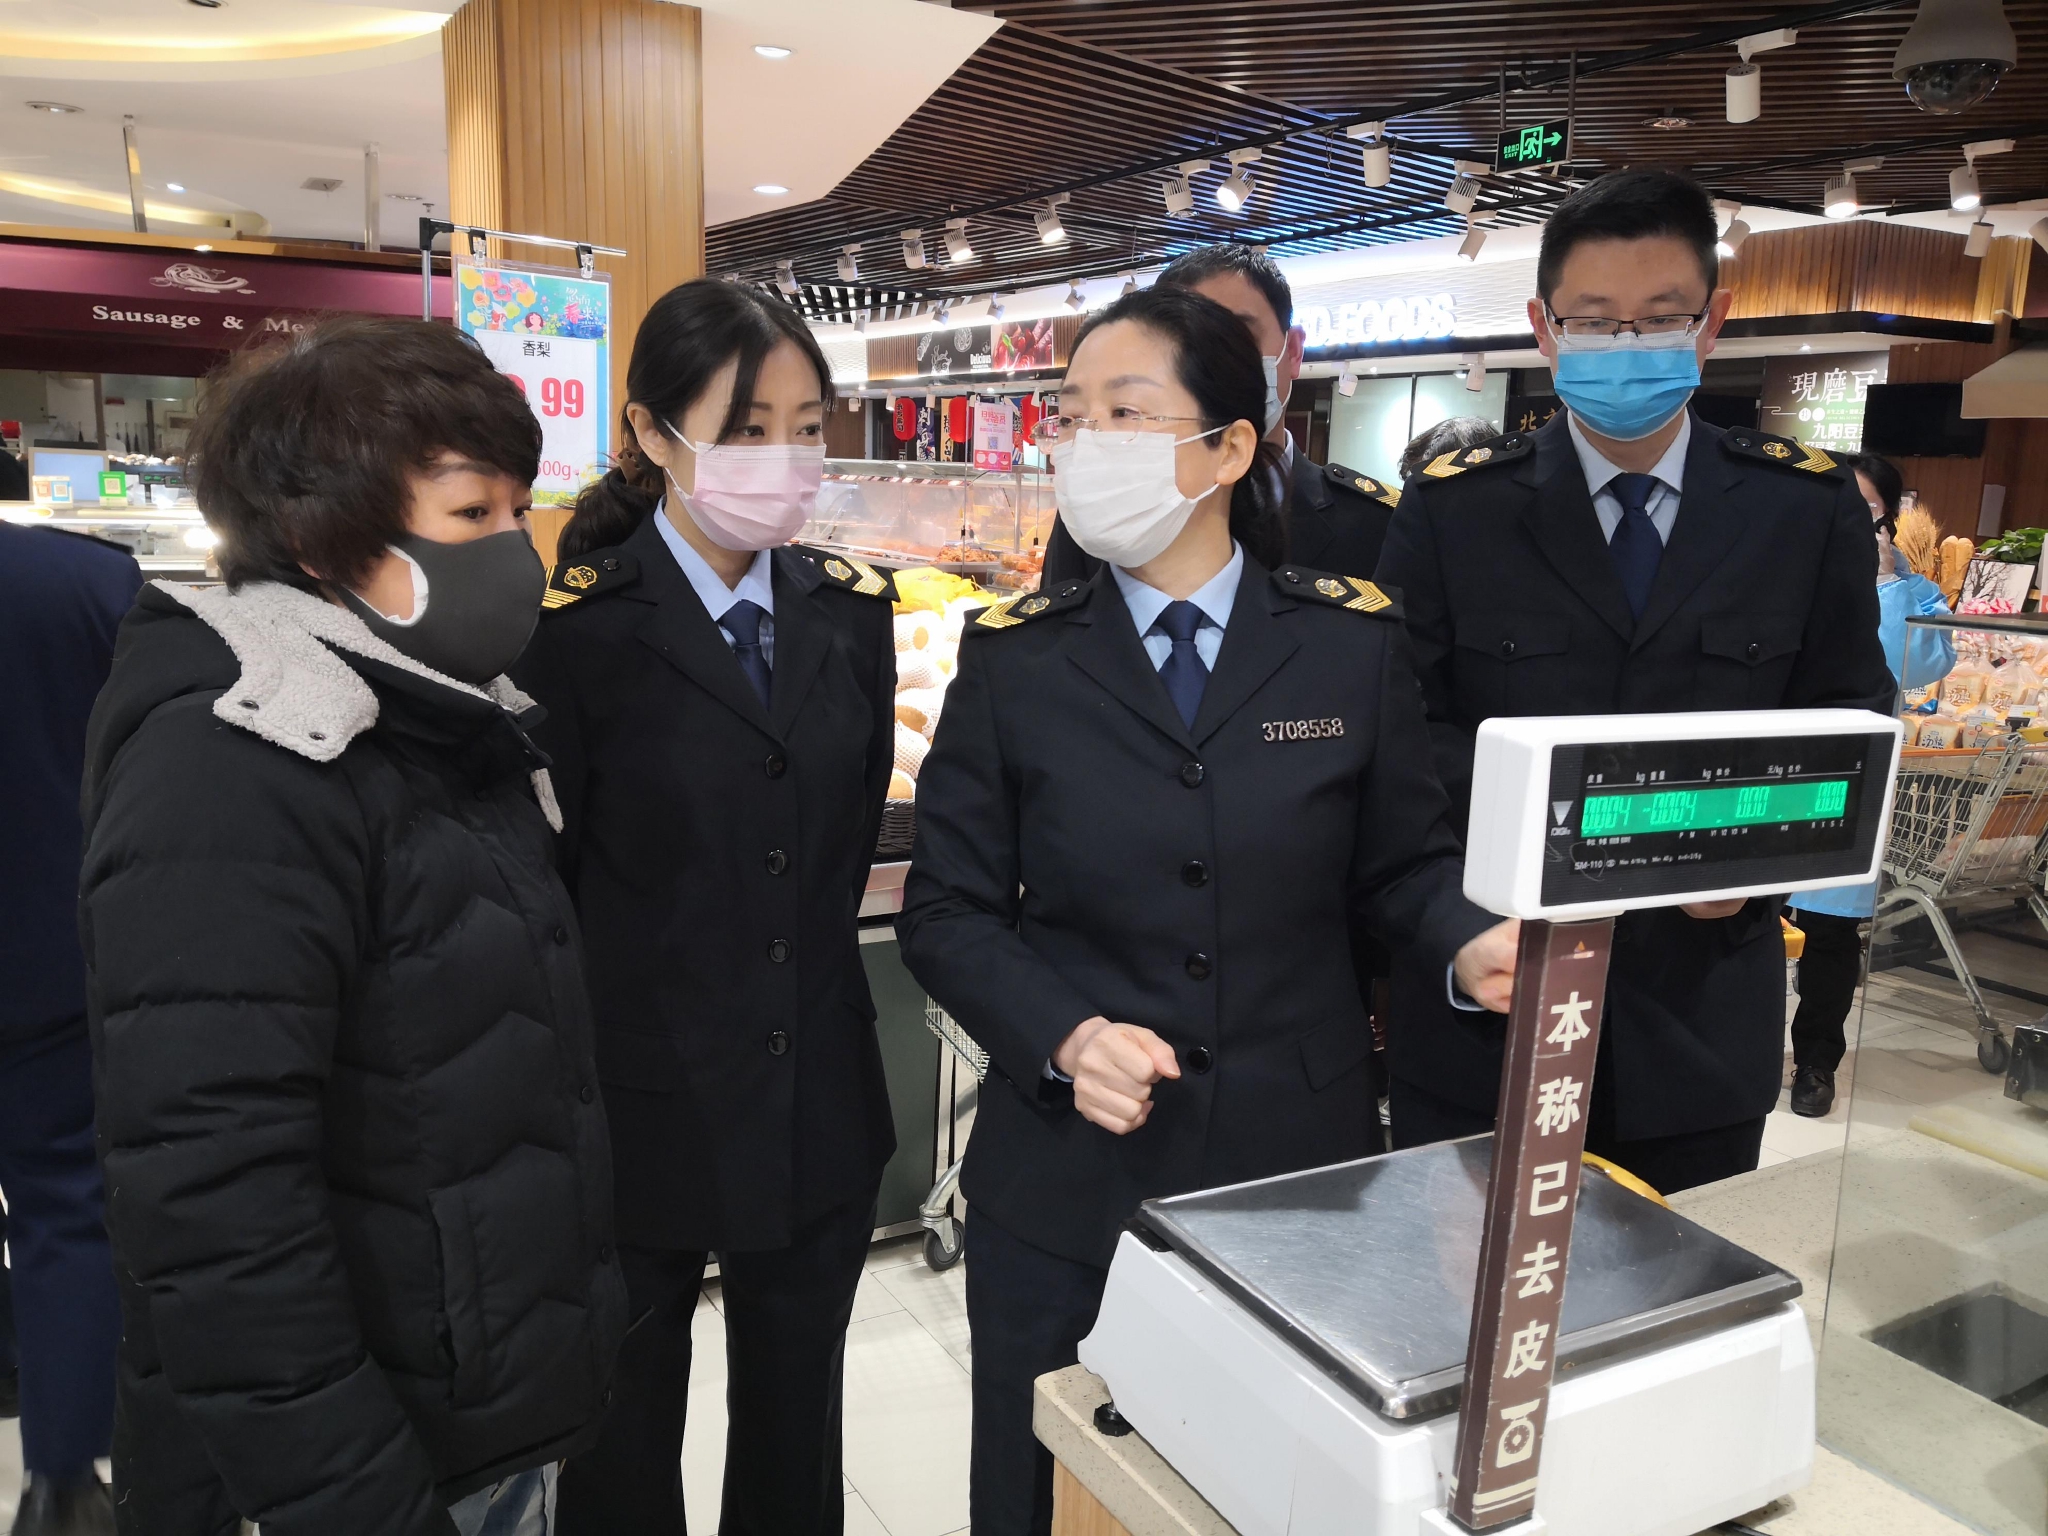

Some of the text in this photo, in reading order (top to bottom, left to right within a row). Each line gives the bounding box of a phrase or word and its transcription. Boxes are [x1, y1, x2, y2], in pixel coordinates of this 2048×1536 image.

[92, 305, 305, 333] Sausage & Me
[1337, 293, 1457, 344] FOODS
[523, 340, 550, 357] 香梨
[1791, 367, 1888, 405] 現磨豆
[1812, 422, 1863, 440] 九阳豆
[538, 460, 571, 481] 00g
[1262, 717, 1344, 741] 3708558
[1635, 771, 1646, 783] kg
[1702, 769, 1712, 780] kg
[1767, 764, 1784, 775] 元/kg
[1574, 860, 1603, 871] SM-110
[1502, 990, 1593, 1380] 本称已去皮
